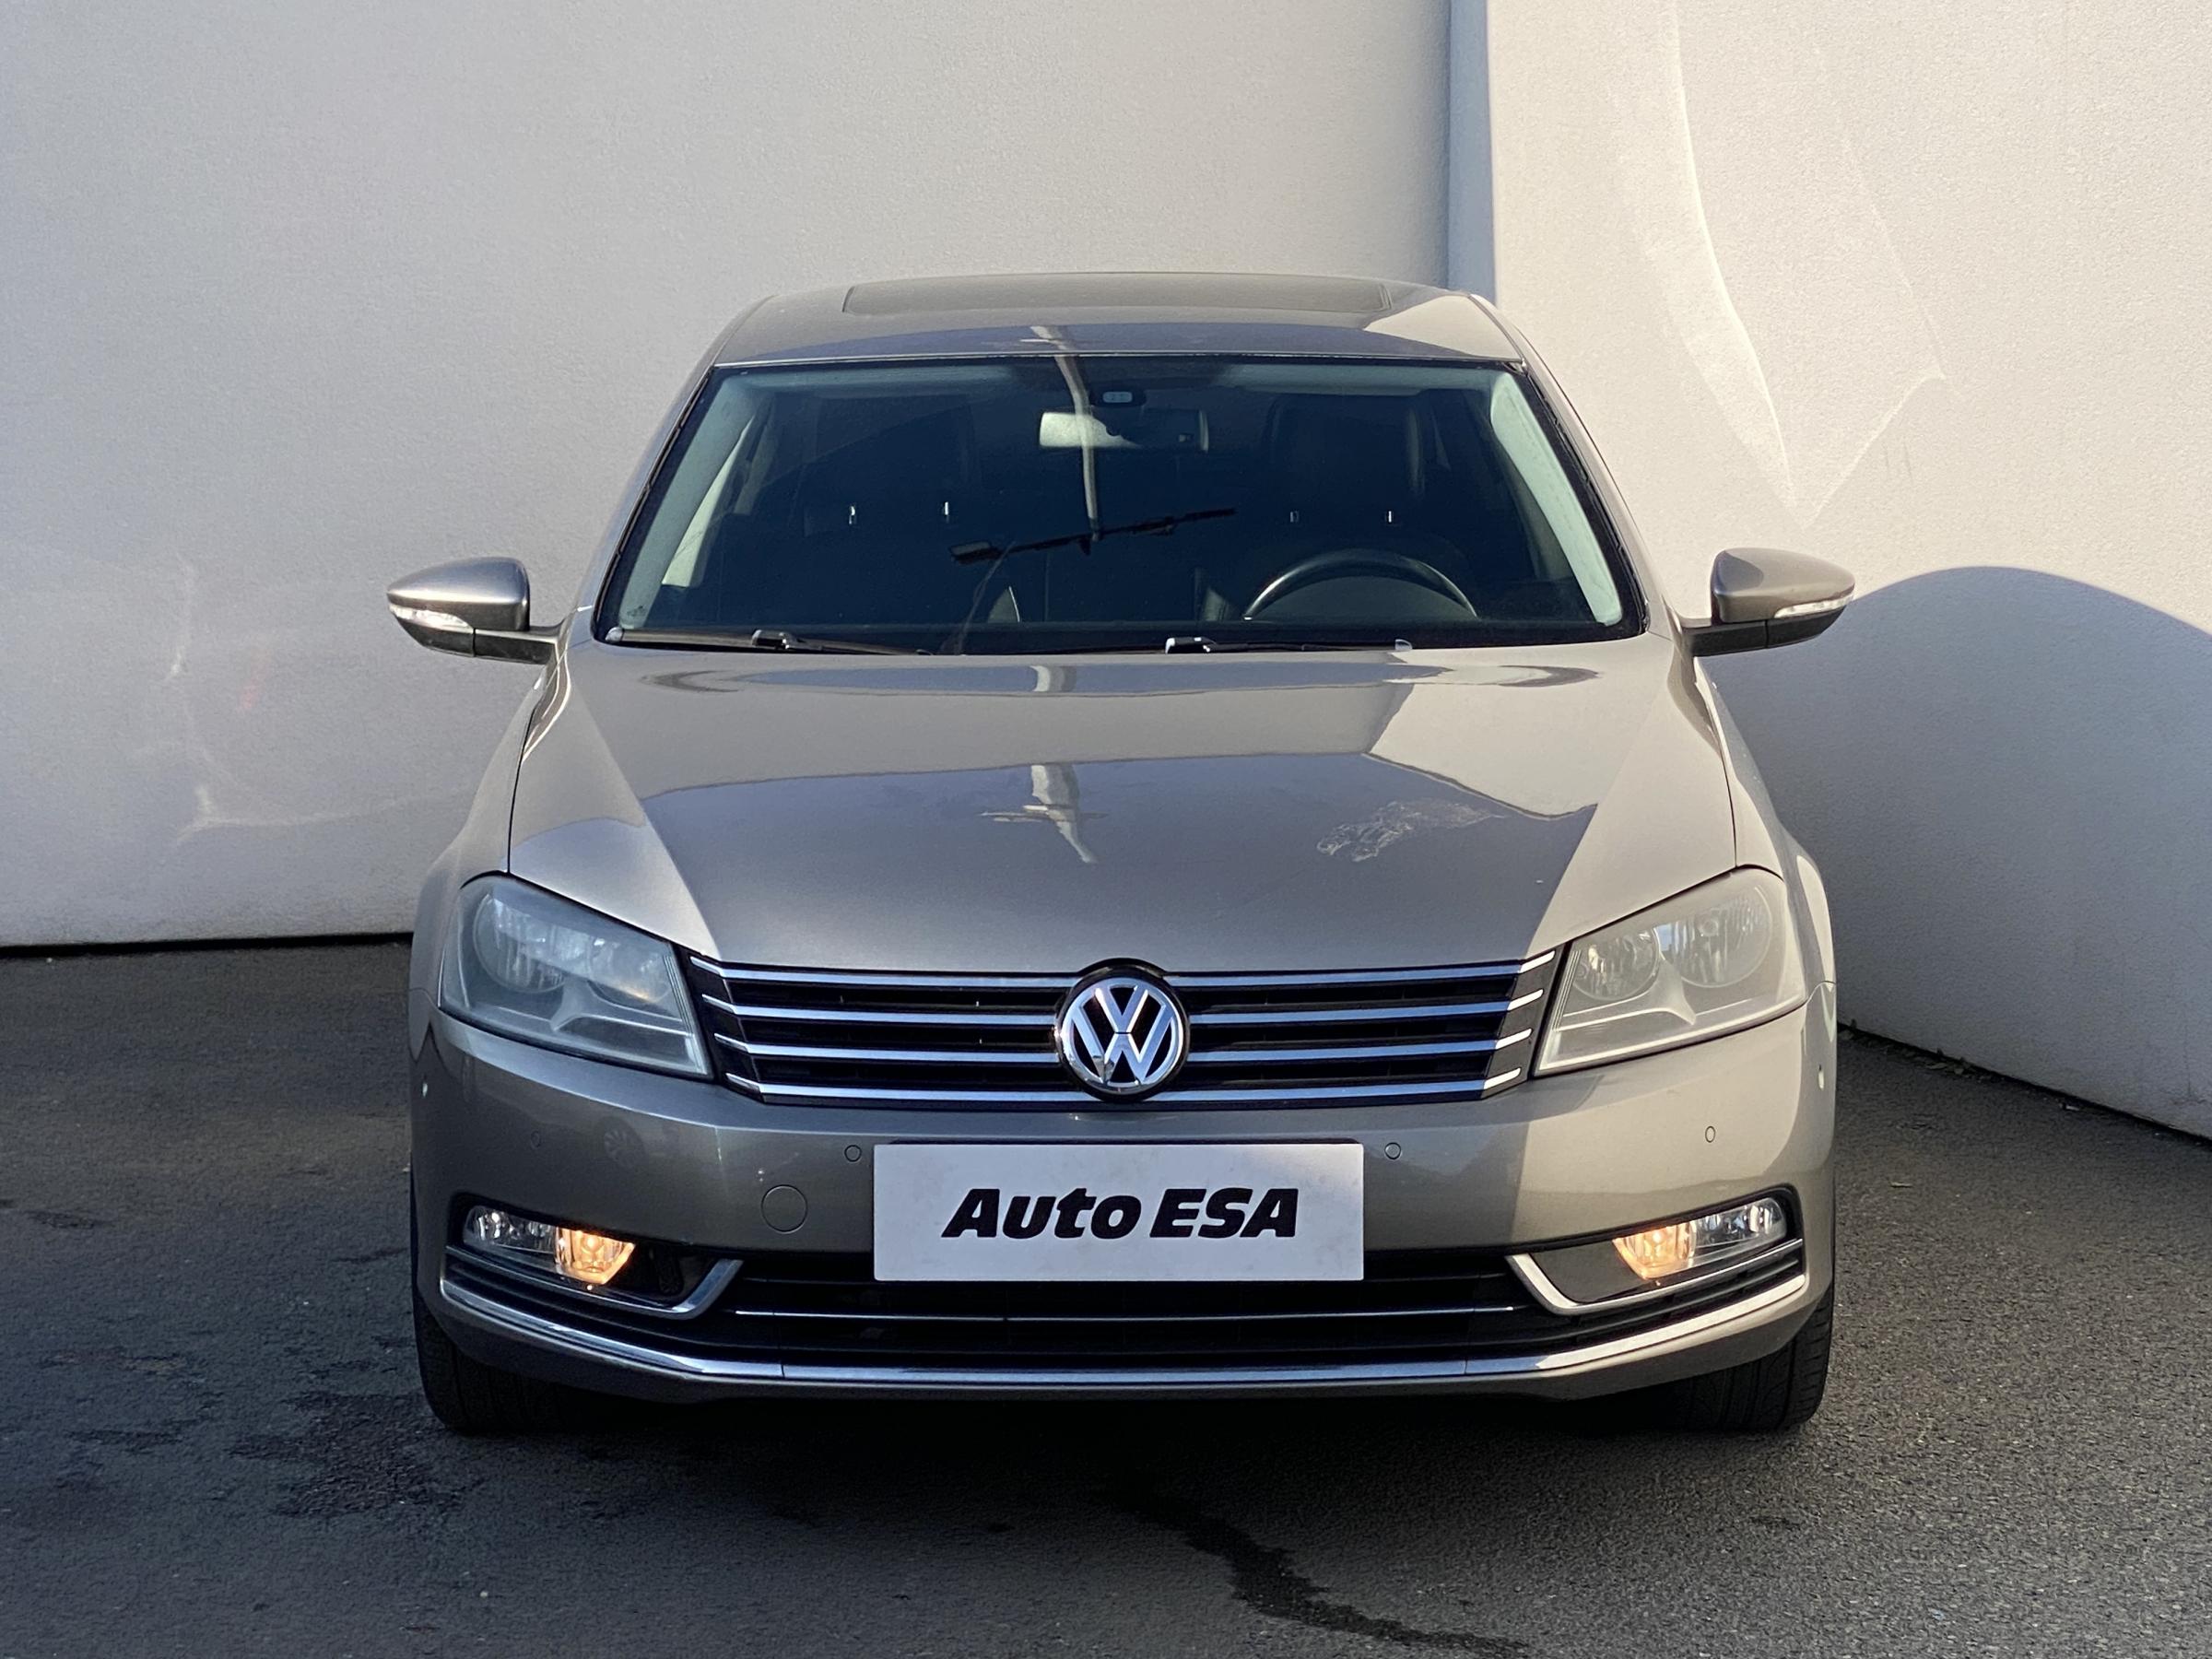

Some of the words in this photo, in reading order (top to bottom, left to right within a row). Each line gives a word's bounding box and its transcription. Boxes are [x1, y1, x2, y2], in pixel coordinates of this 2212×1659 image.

[1066, 980, 1179, 1088] VW
[941, 1187, 1142, 1240] Auto
[1149, 1186, 1299, 1239] ESA
